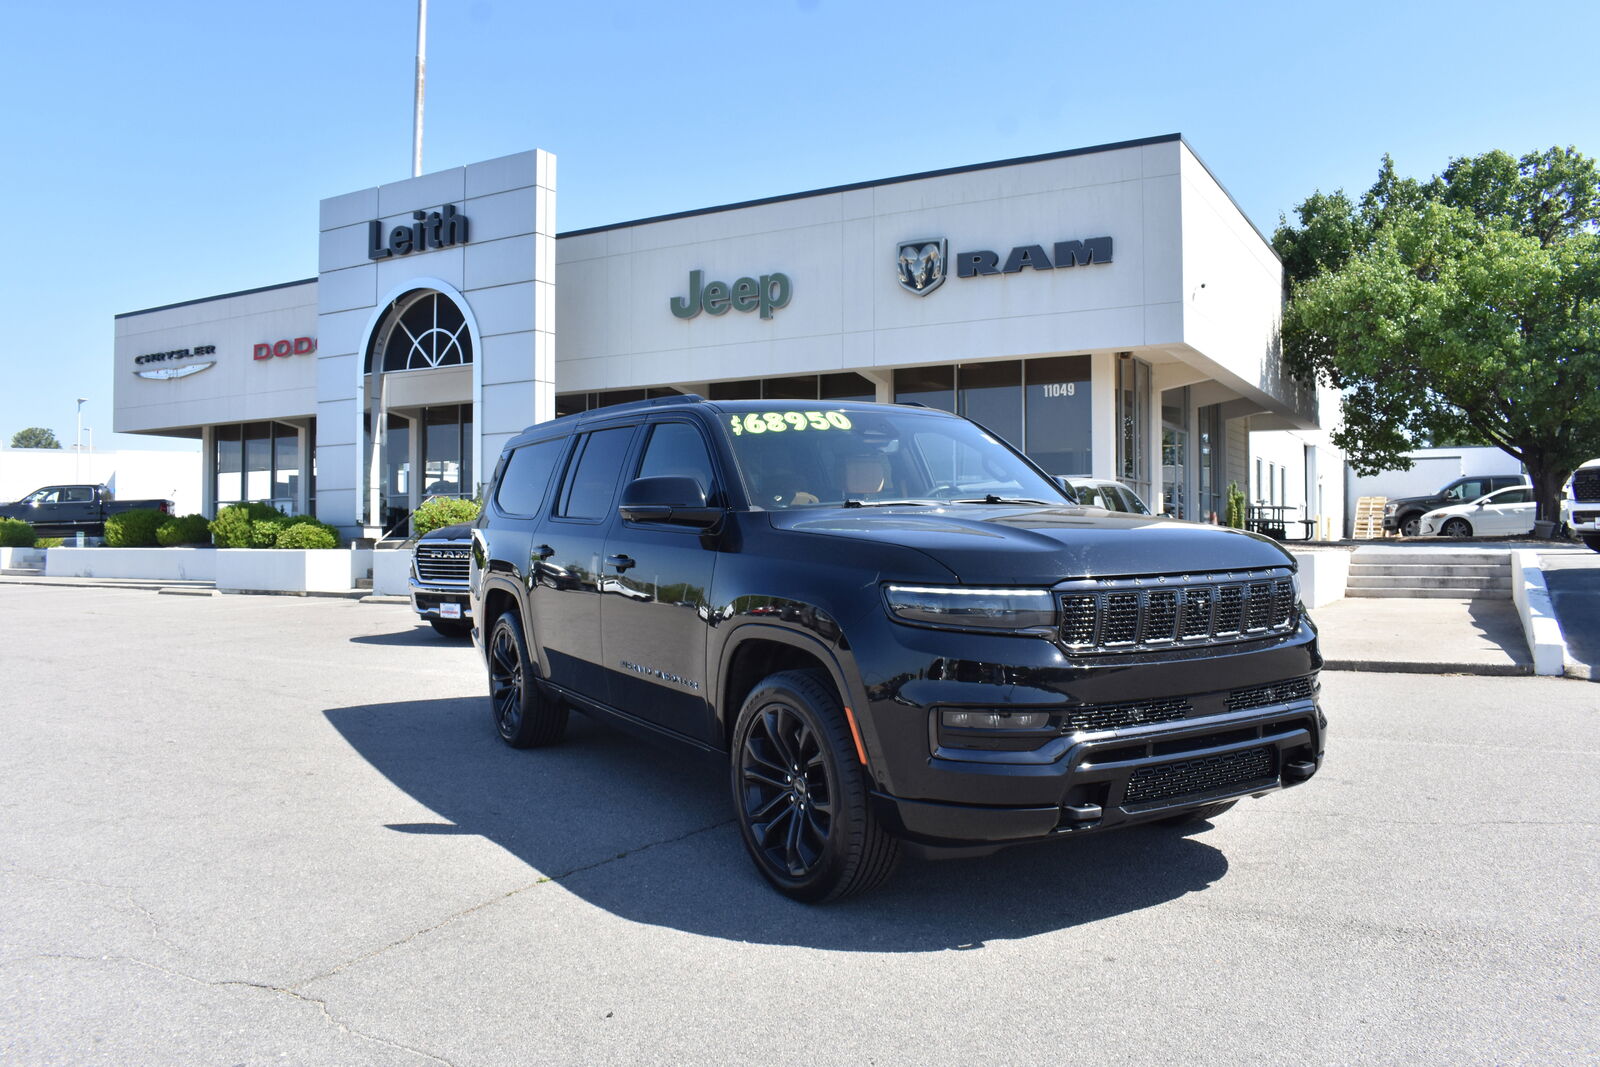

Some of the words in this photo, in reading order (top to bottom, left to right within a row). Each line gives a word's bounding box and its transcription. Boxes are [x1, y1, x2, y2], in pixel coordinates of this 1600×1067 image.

[368, 204, 469, 260] Leith
[957, 236, 1113, 278] RAM
[670, 269, 793, 321] Jeep
[134, 345, 216, 365] CHRYSLER
[253, 336, 318, 361] DOD
[1043, 382, 1075, 398] 11049
[731, 411, 852, 436] $68950
[430, 550, 470, 559] RAM
